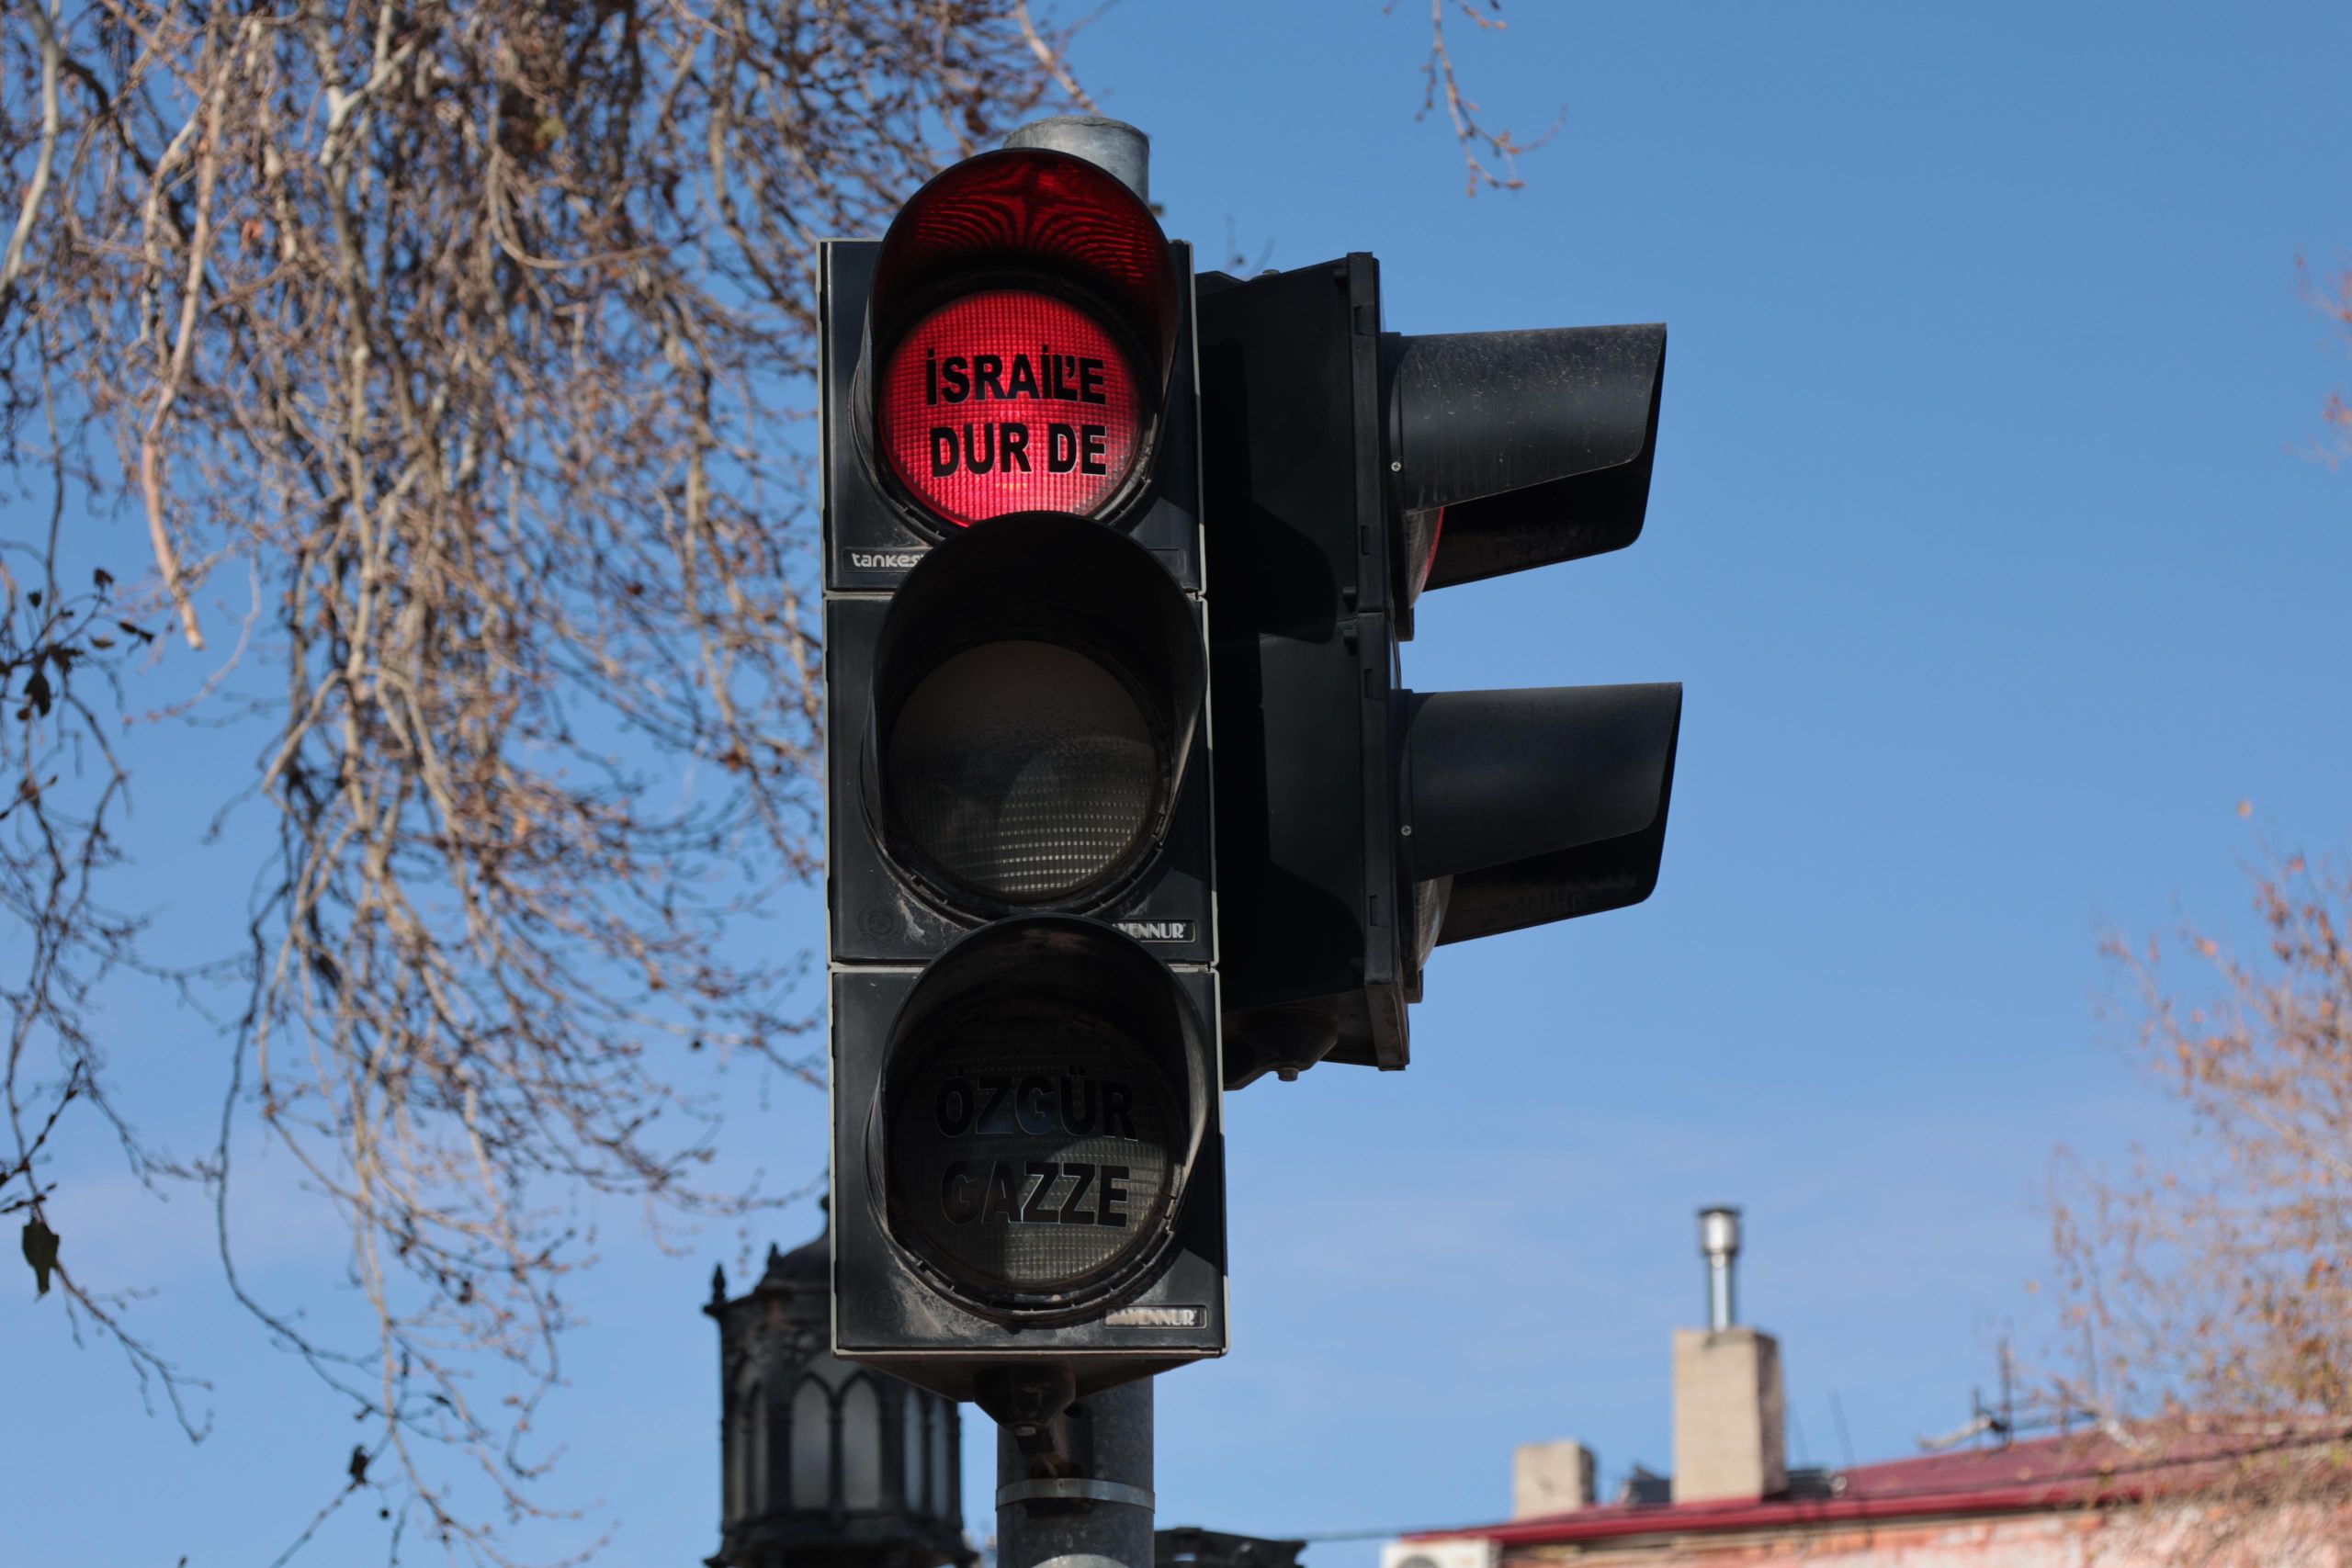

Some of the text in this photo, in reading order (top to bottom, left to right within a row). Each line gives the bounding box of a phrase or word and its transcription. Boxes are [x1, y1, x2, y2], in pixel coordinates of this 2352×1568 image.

[931, 422, 1108, 478] DUR DE
[934, 1066, 1139, 1142] ÖZGÜR
[939, 1159, 1132, 1228] GAZZE
